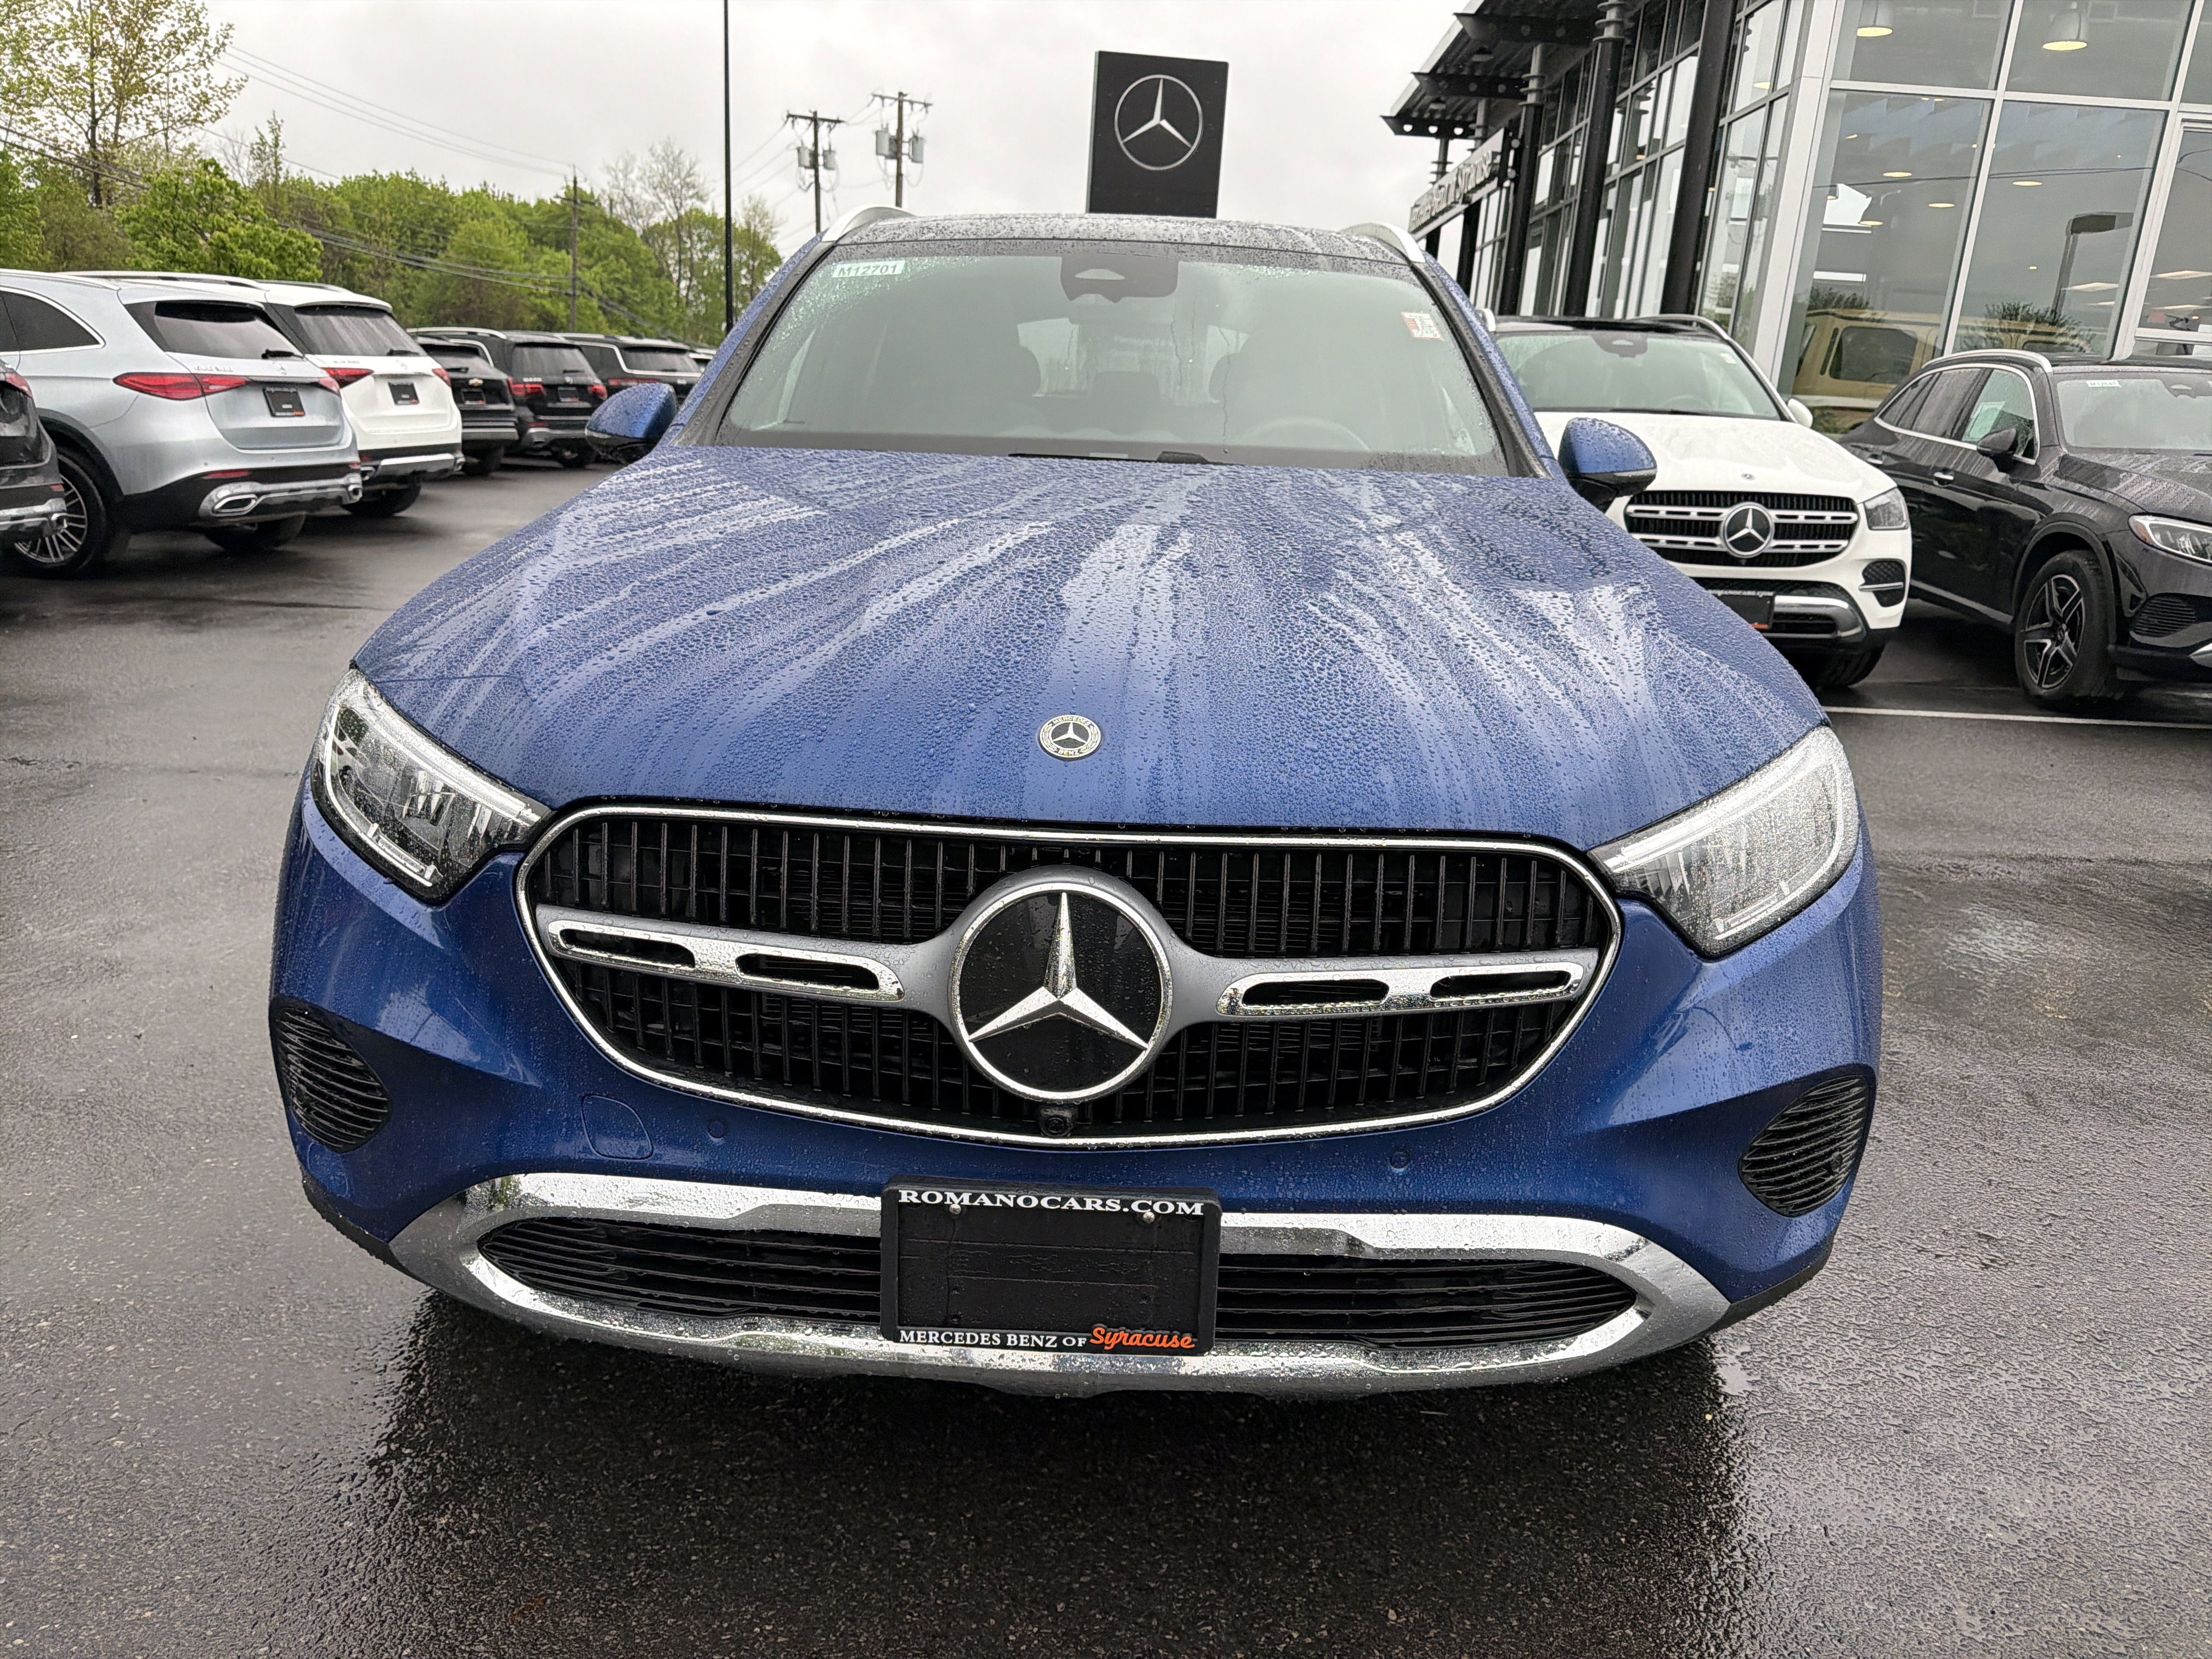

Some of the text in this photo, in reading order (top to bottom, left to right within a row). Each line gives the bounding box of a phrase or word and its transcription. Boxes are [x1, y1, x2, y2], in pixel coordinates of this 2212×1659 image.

[837, 264, 898, 276] M12701
[1052, 716, 1091, 725] MERCEDES
[898, 1189, 1204, 1215] ROMANOCARS.COM
[899, 1327, 1195, 1350] MERCEDES BENZ OF Syracuse
